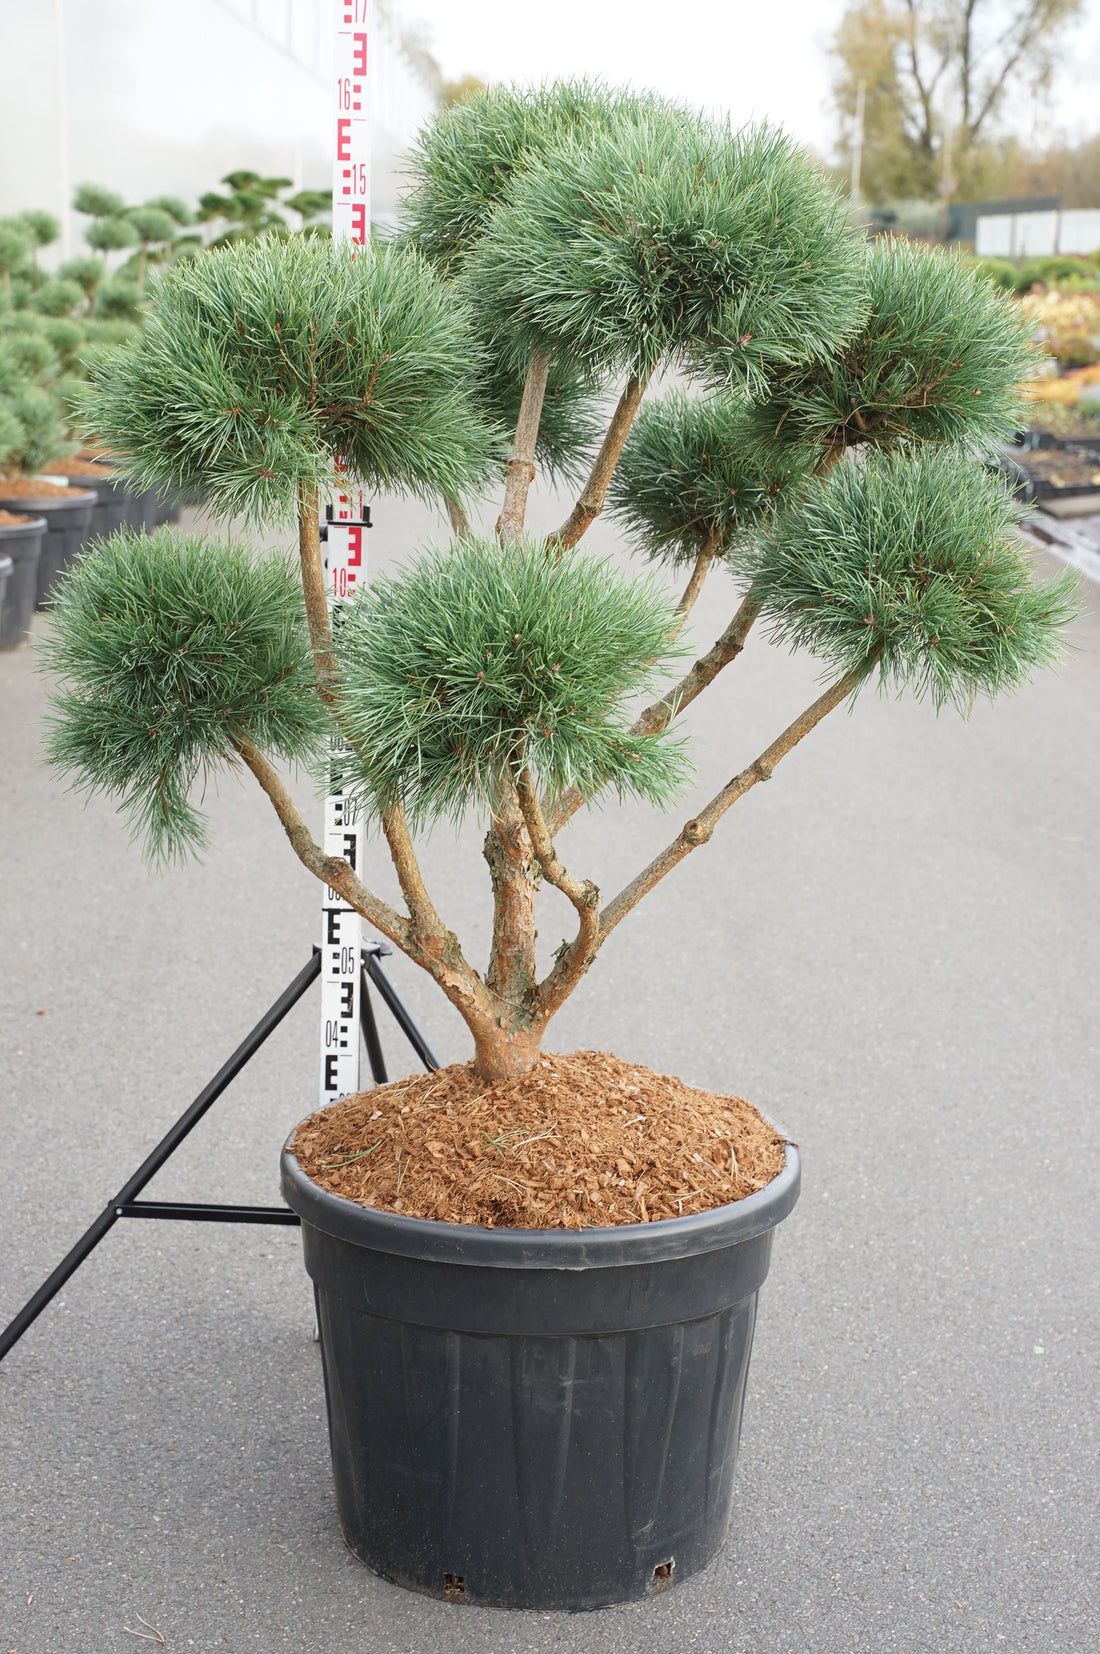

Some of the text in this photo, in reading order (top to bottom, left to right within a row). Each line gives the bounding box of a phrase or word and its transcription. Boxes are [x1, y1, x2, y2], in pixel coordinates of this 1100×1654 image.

[337, 78, 350, 110] 16
[352, 163, 366, 195] 15
[333, 568, 347, 598] 10
[341, 946, 355, 974] 05
[325, 1020, 338, 1048] 04
